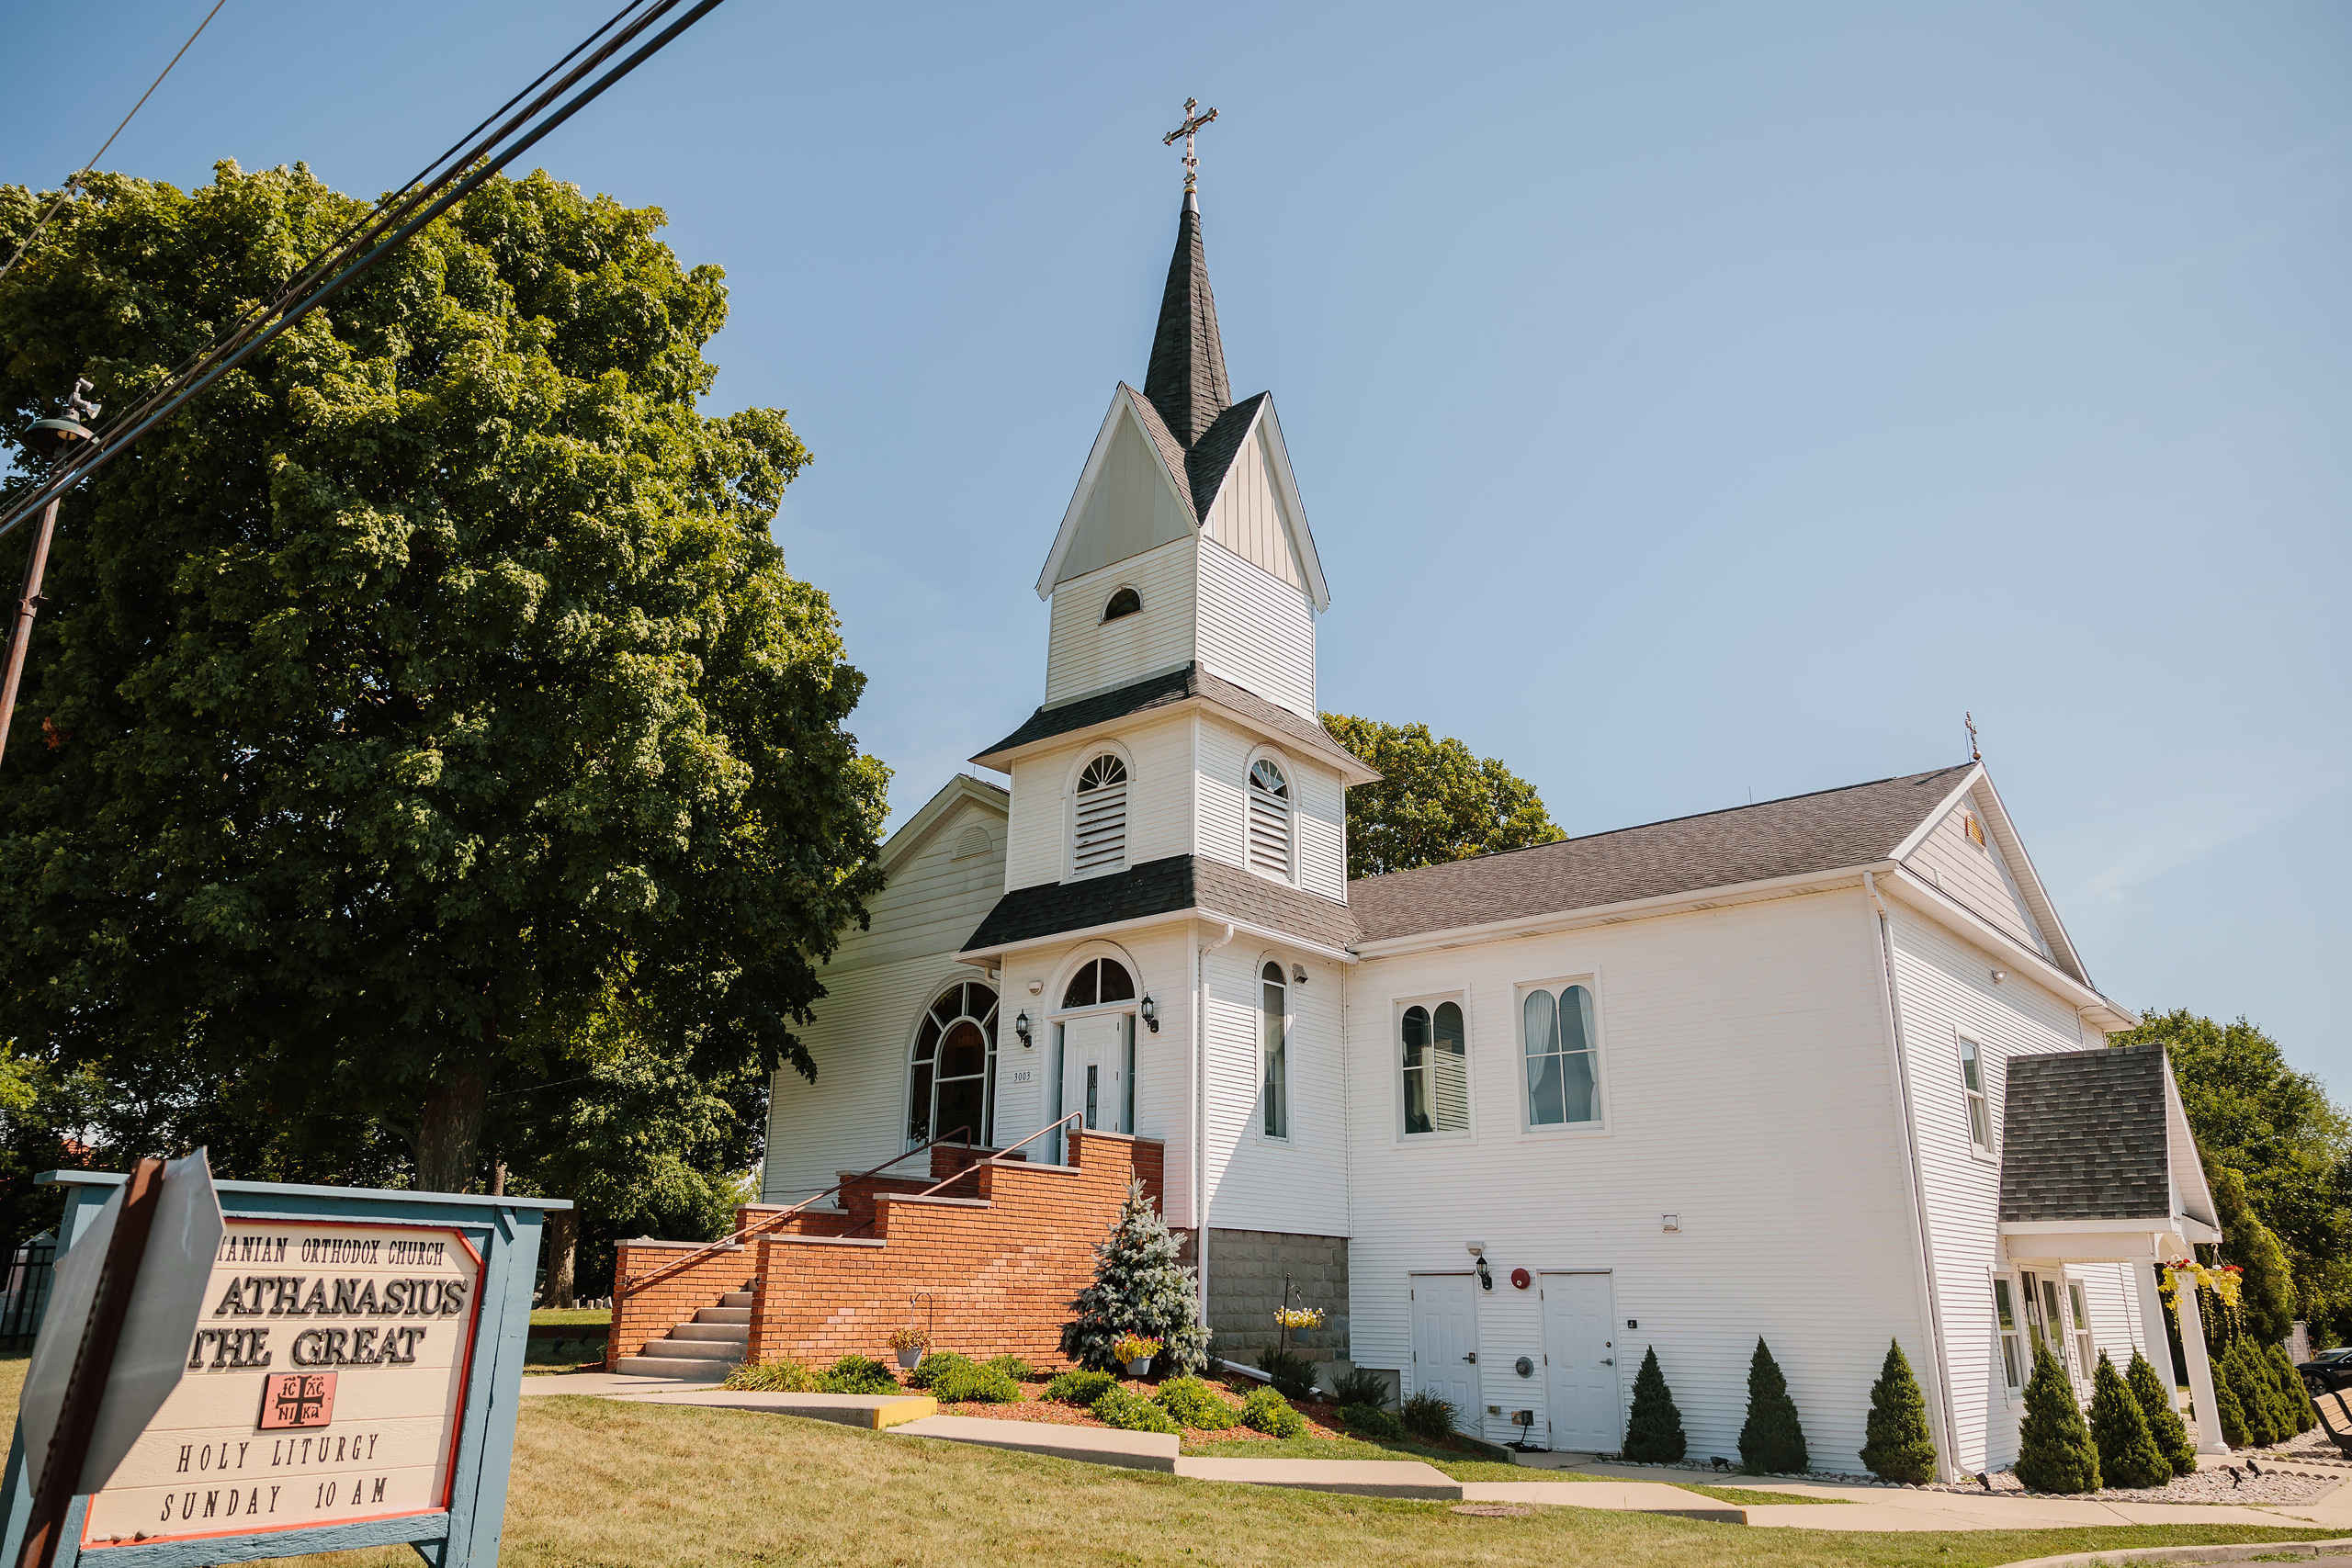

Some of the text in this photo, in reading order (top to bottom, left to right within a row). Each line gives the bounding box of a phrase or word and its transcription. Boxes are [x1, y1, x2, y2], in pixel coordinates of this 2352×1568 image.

[1013, 1071, 1031, 1082] 3003
[301, 1237, 381, 1265] ORTHODOX
[388, 1240, 446, 1266] CHURCH
[215, 1275, 469, 1315] ATHANASIUS
[187, 1325, 427, 1369] THE GREAT
[175, 1433, 379, 1473] HOLY LITURGY
[160, 1476, 388, 1522] SUNDAY 10 AM
